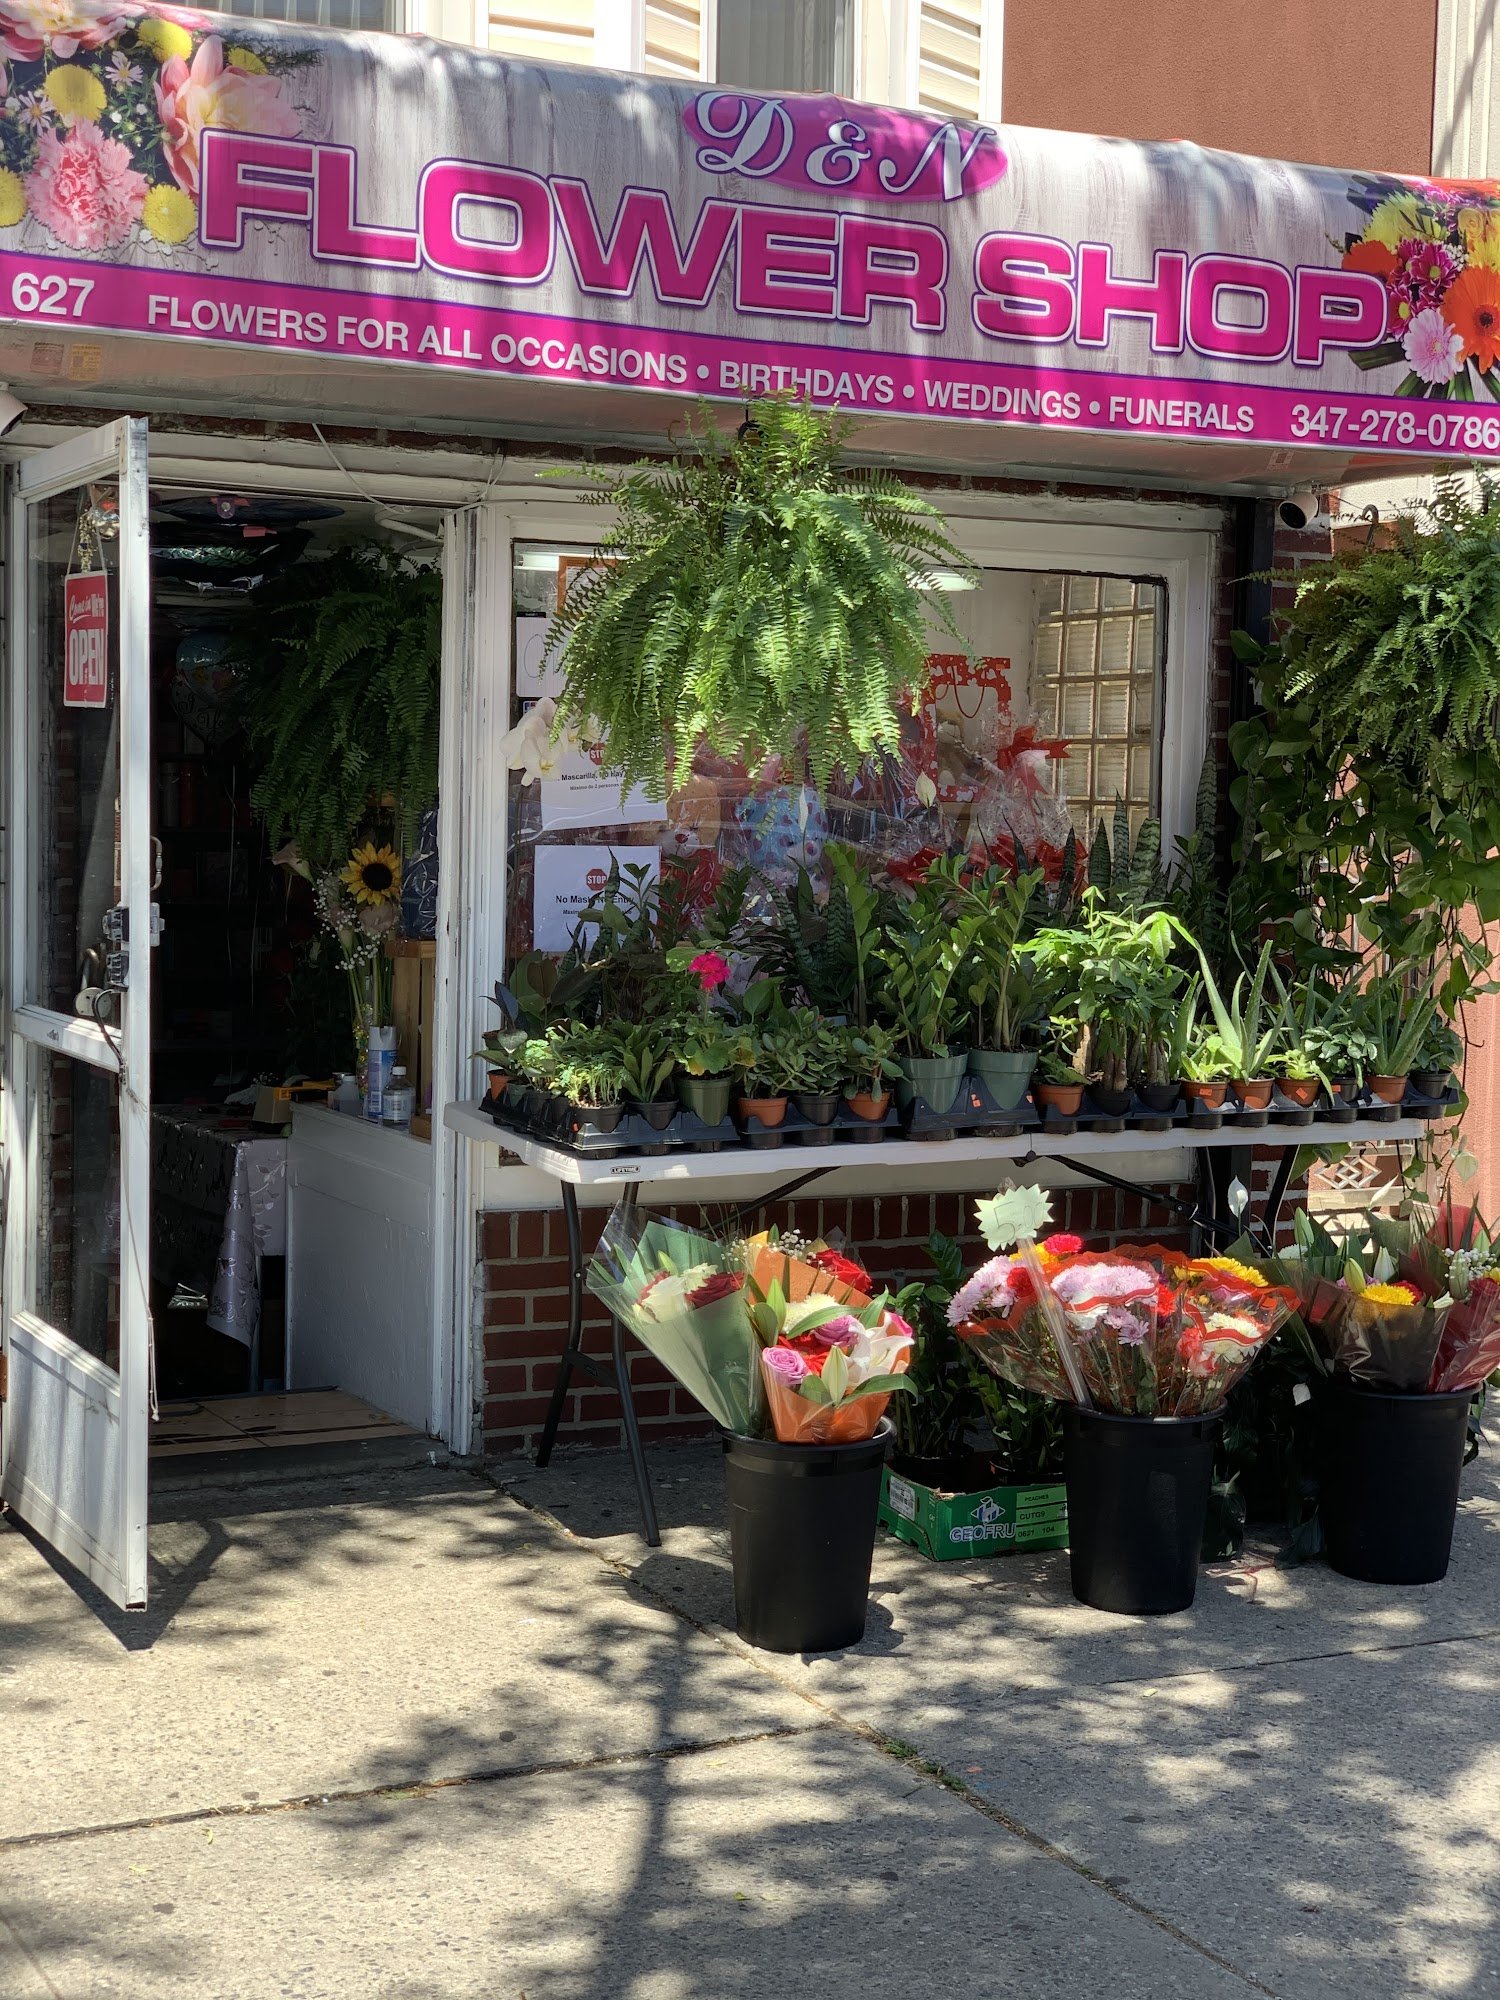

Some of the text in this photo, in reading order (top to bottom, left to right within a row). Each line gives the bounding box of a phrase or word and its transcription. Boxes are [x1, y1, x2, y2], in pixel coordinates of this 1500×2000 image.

[696, 91, 997, 200] D & N
[199, 128, 1388, 368] FLOWER SHOP
[11, 272, 95, 317] 627
[148, 294, 1254, 433] FLOWERS FOR ALL OCCASIONS BIRTHDAYS WEDDINGS FUNERALS
[1290, 404, 1499, 450] 347-278-0786
[69, 629, 104, 685] OPEN
[556, 895, 568, 904] No
[587, 875, 607, 885] STOP
[1025, 1494, 1049, 1502] PEACHES
[950, 1523, 1016, 1543] GEOFRU
